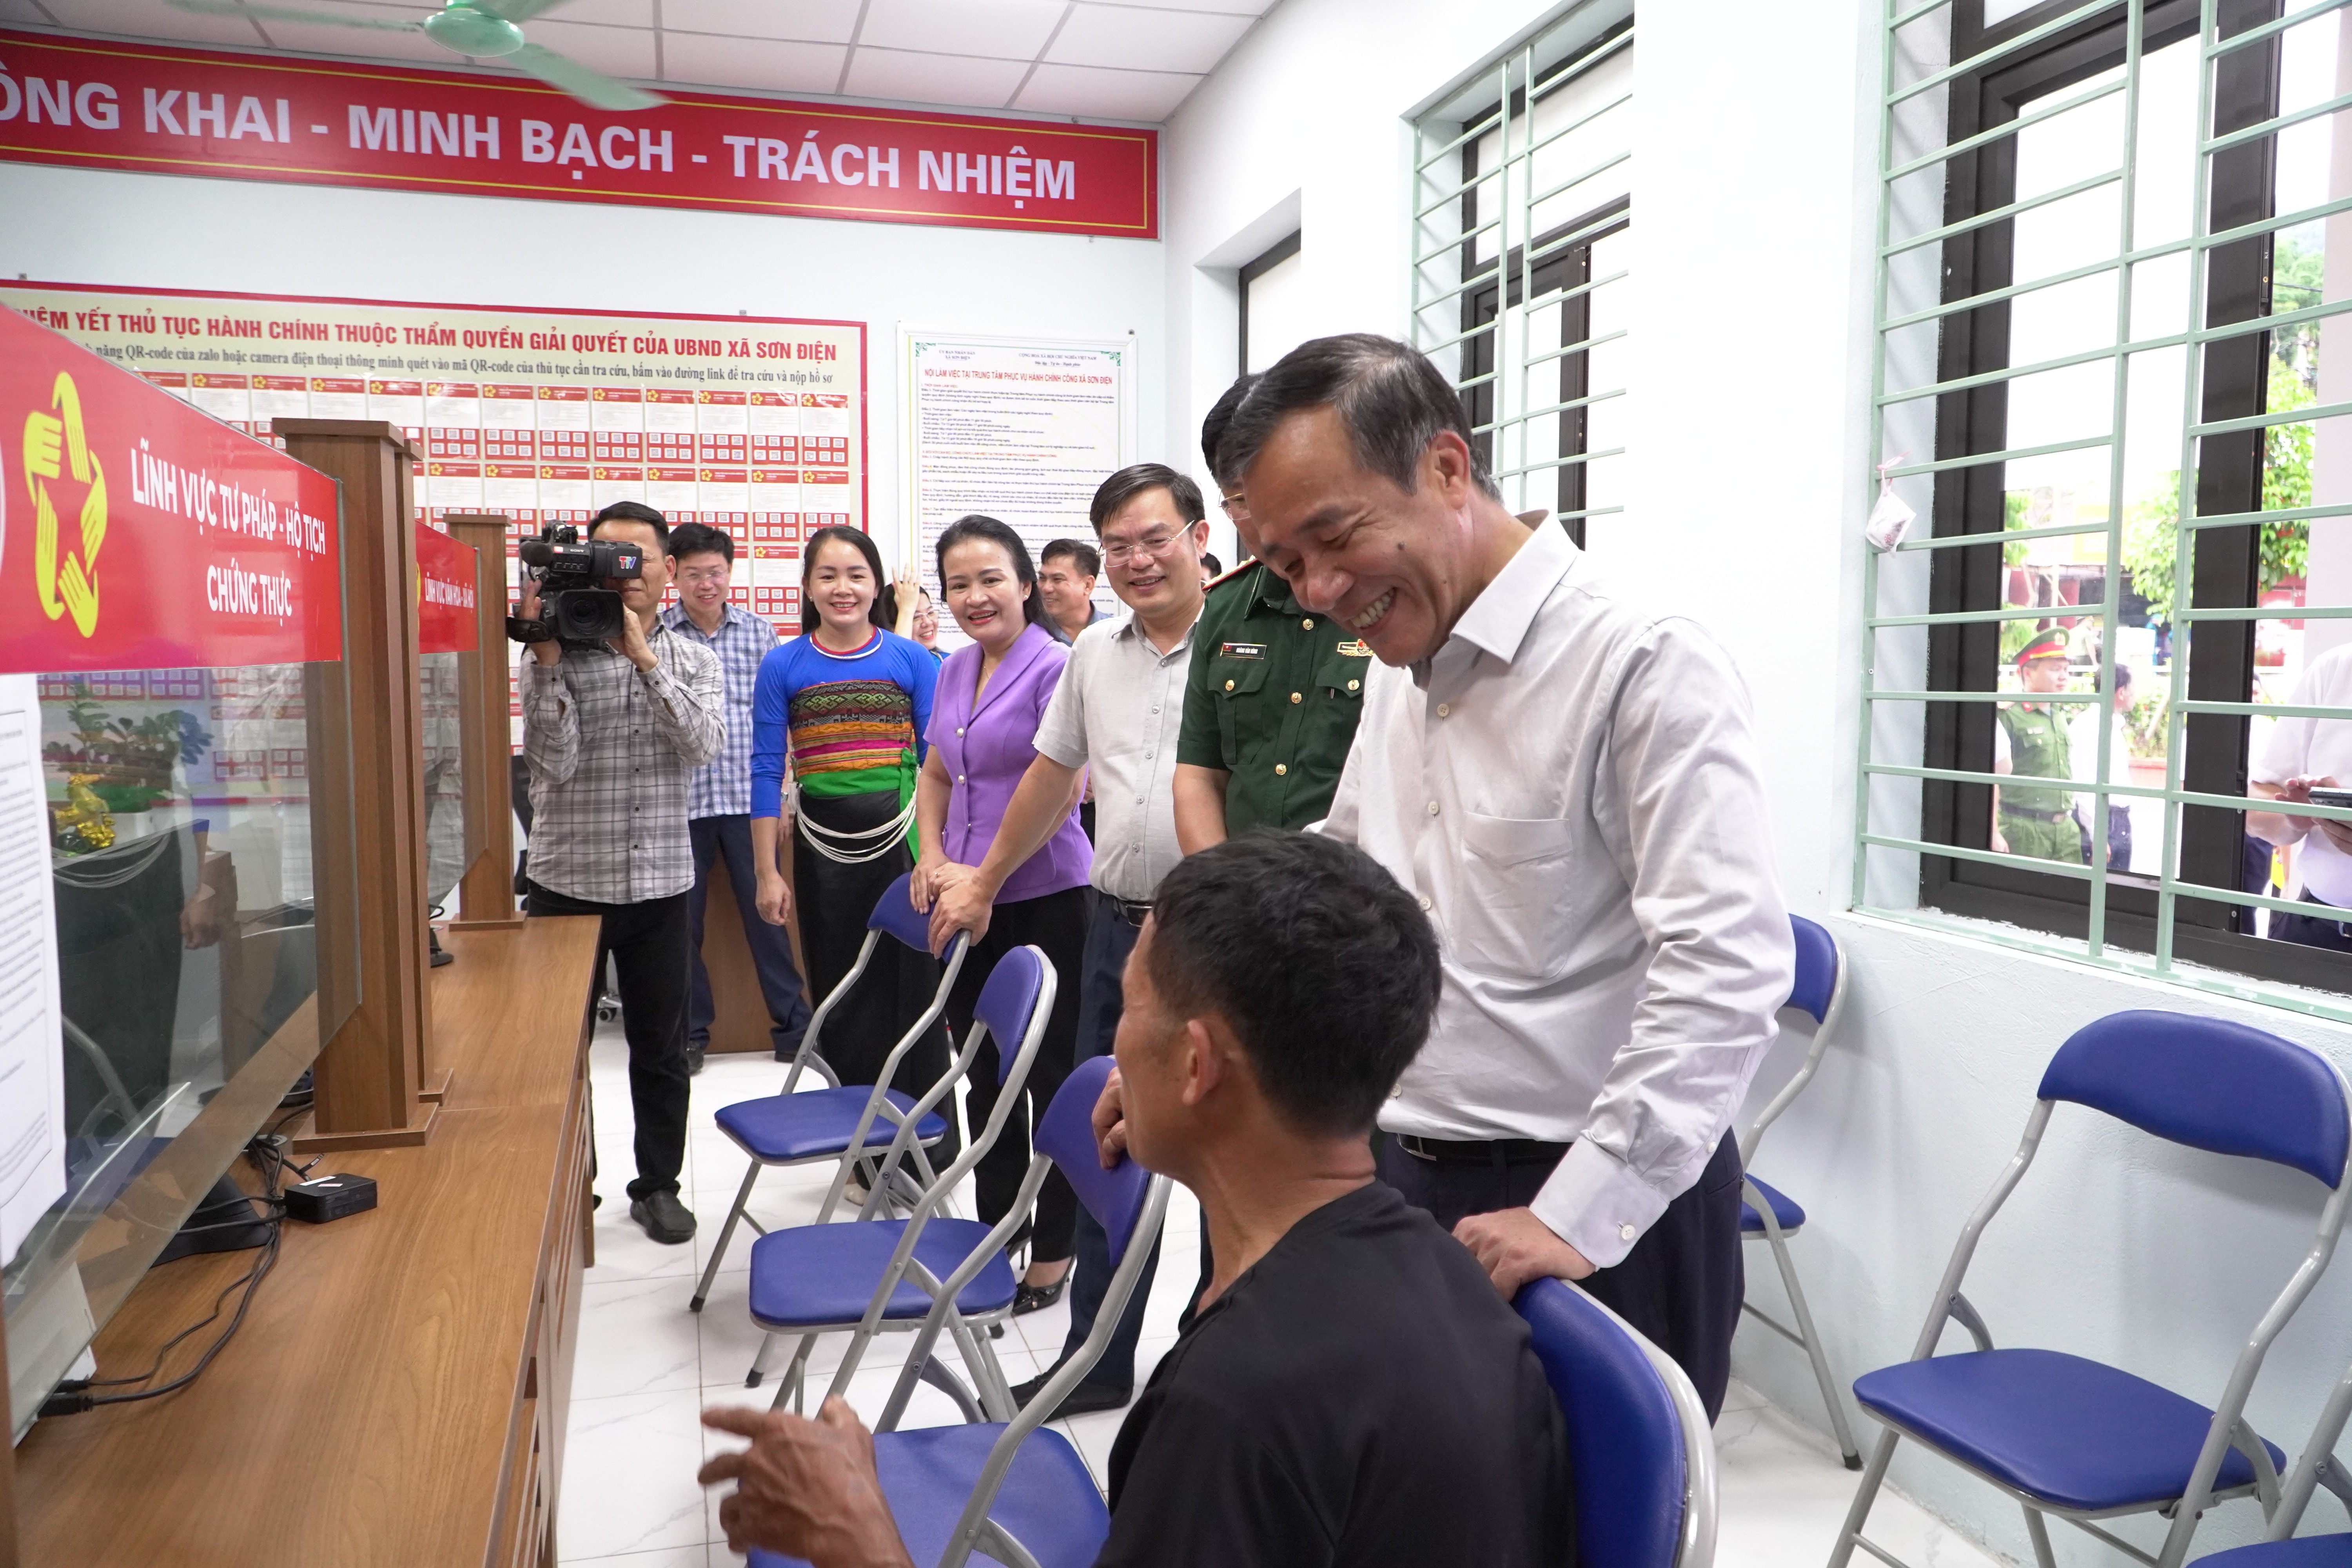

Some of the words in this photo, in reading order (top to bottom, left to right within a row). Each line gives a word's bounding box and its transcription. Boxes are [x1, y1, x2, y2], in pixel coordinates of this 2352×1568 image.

[144, 88, 291, 144] KHAI
[311, 125, 328, 134] -
[348, 105, 500, 160] MINH
[521, 119, 673, 180] BẠCH
[692, 154, 707, 163] -
[723, 130, 900, 188] TRÁCH
[918, 145, 1074, 209] NHIỆM
[22, 306, 68, 330] ÊM
[75, 306, 111, 331] YẾT
[117, 308, 156, 334] THỦ
[162, 316, 200, 339] TỤC
[207, 315, 262, 338] HÀNH
[268, 318, 328, 341] CHÍNH
[334, 322, 397, 347] THUỘC
[403, 321, 456, 346] THẨM
[463, 326, 523, 349] QUYỀN
[529, 327, 566, 350] GIẢI
[572, 330, 627, 353] QUYẾT
[633, 330, 669, 355] CỦA
[674, 338, 722, 356] UBND
[728, 338, 750, 358] XÃ
[756, 341, 791, 359] SƠN
[797, 341, 836, 364] ĐIỆN
[125, 345, 173, 361] QR-code
[176, 347, 195, 360] của
[198, 348, 220, 361] zalo
[222, 348, 247, 365] hoặc
[250, 354, 289, 364] camera
[291, 352, 314, 368] điện
[316, 353, 343, 369] thoại
[345, 354, 376, 371] thông
[377, 356, 404, 368] minh
[407, 357, 429, 373] quét
[432, 358, 450, 370] vào
[452, 359, 468, 371] mã
[470, 359, 514, 374] QR-code
[516, 361, 534, 373] của
[536, 360, 553, 374] thủ
[555, 364, 570, 377] tục
[573, 359, 590, 375] cần
[592, 365, 607, 376] tra
[609, 364, 630, 377] cứu,
[632, 361, 653, 377] bấm
[655, 366, 672, 378] vào
[674, 367, 705, 383] đường
[707, 368, 725, 380] link
[728, 365, 739, 380] để
[741, 370, 755, 381] tra
[757, 369, 774, 381] cứu
[777, 370, 787, 382] và
[789, 370, 807, 386] nộp
[809, 368, 820, 383] hồ
[822, 375, 833, 383] sơ
[925, 368, 934, 378] NỘI
[936, 367, 947, 377] LÀM
[948, 369, 960, 379] VIỆC
[962, 370, 971, 379] TẠI
[992, 370, 1003, 379] TÂM
[1004, 372, 1019, 381] PHỤC
[1020, 373, 1027, 382] VỤ
[1029, 372, 1044, 381] HÀNH
[1045, 373, 1061, 382] CHÍNH
[1063, 373, 1078, 383] CÔNG
[1079, 374, 1086, 383] XÃ
[1100, 376, 1112, 386] ĐIỆN
[131, 437, 178, 514] LĨNH
[180, 468, 217, 535] VỰC
[219, 481, 239, 532] TƯ
[241, 488, 276, 541] PHÁP
[285, 500, 302, 558] HỘ
[302, 514, 325, 561] TỊCH
[207, 557, 258, 614] CHỨNG
[259, 570, 292, 626] THỰC
[619, 556, 637, 570] TTV
